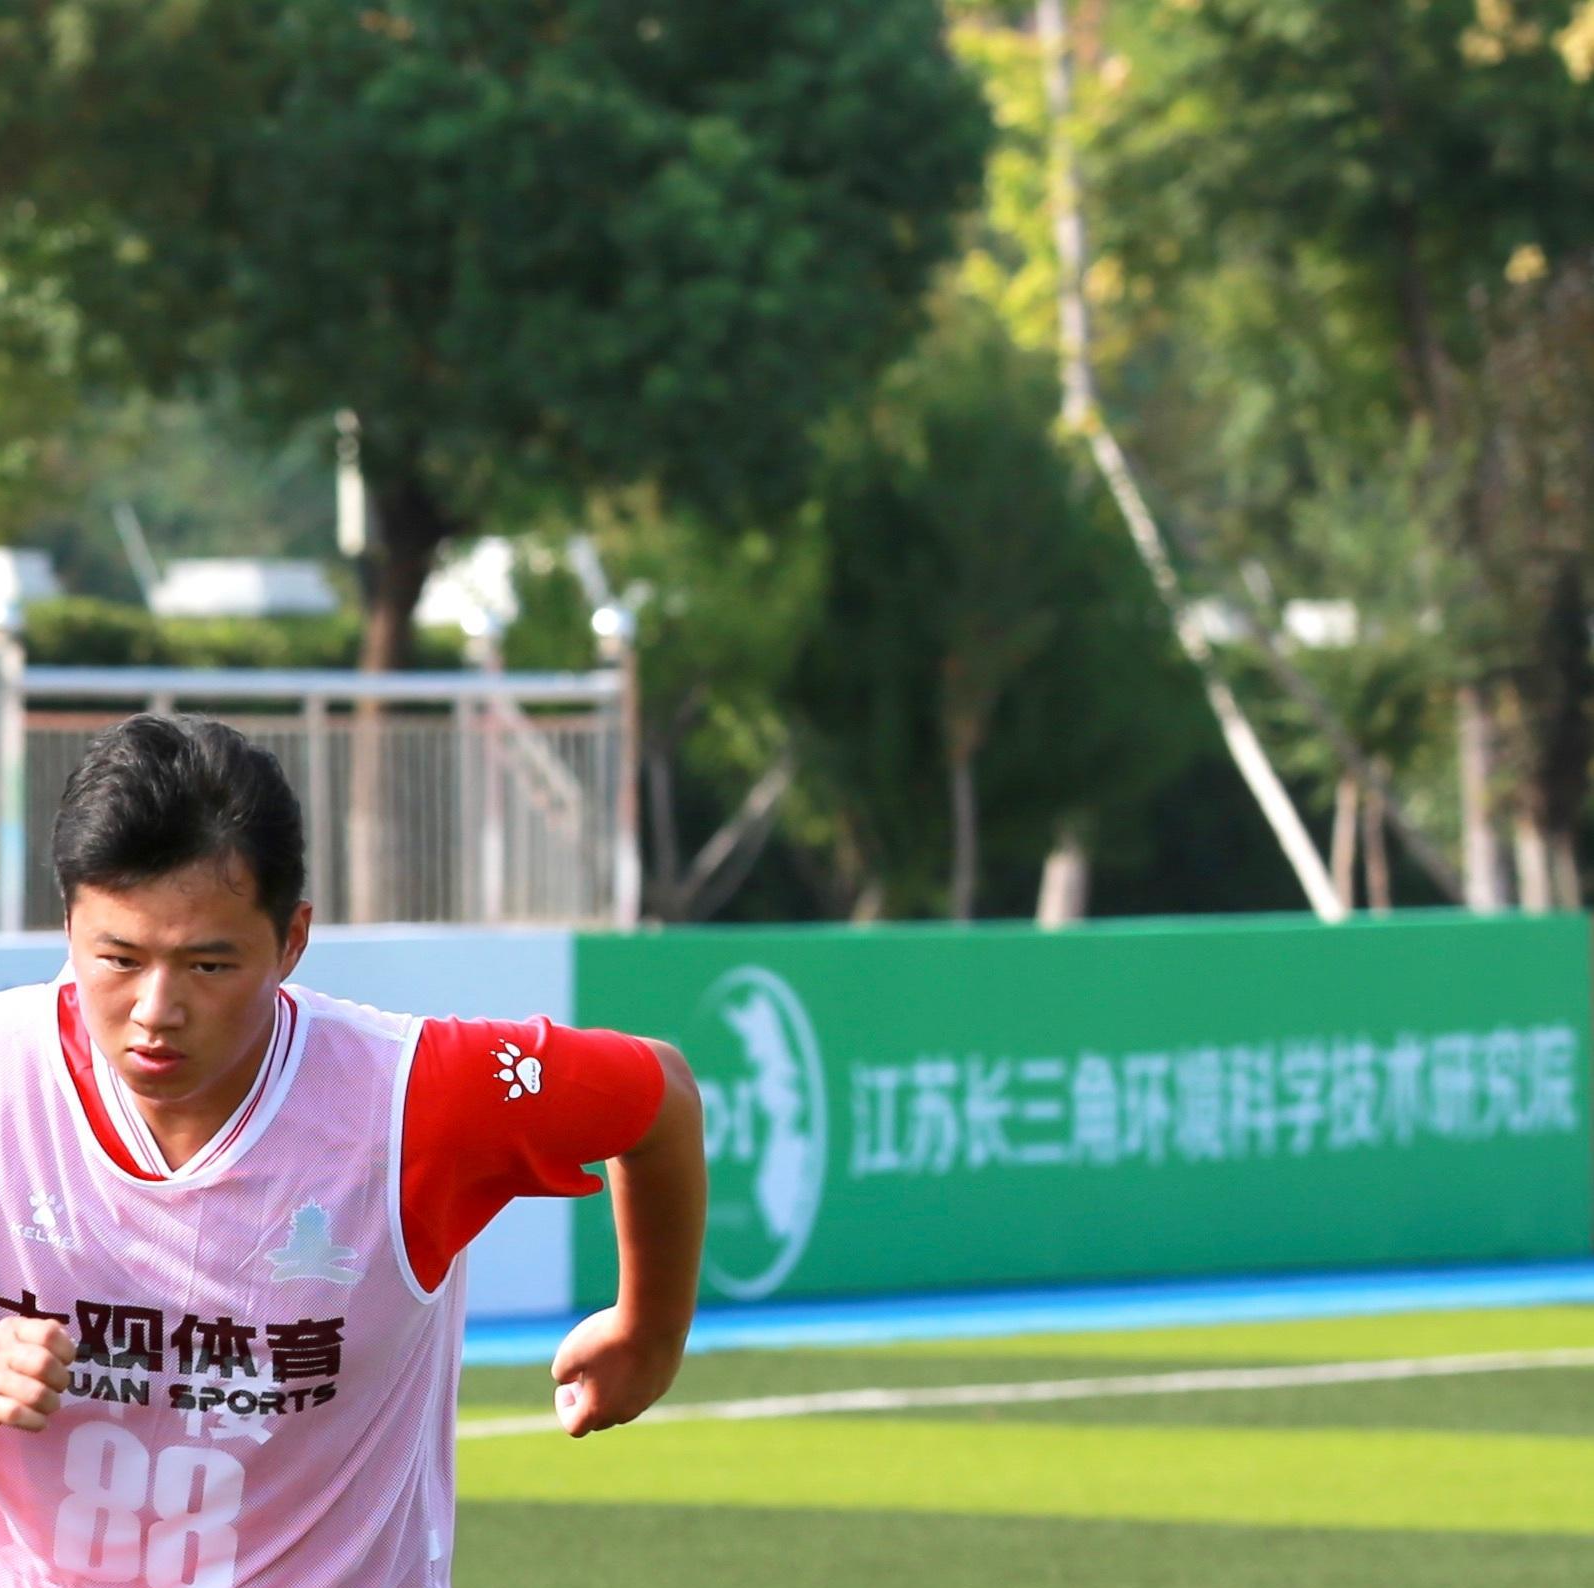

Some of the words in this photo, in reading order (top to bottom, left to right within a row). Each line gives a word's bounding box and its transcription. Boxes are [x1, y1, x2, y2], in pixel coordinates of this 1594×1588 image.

[851, 1023, 1578, 1176] 江苏长三角环境科学技术研究院
[168, 1380, 338, 1416] SPORTS
